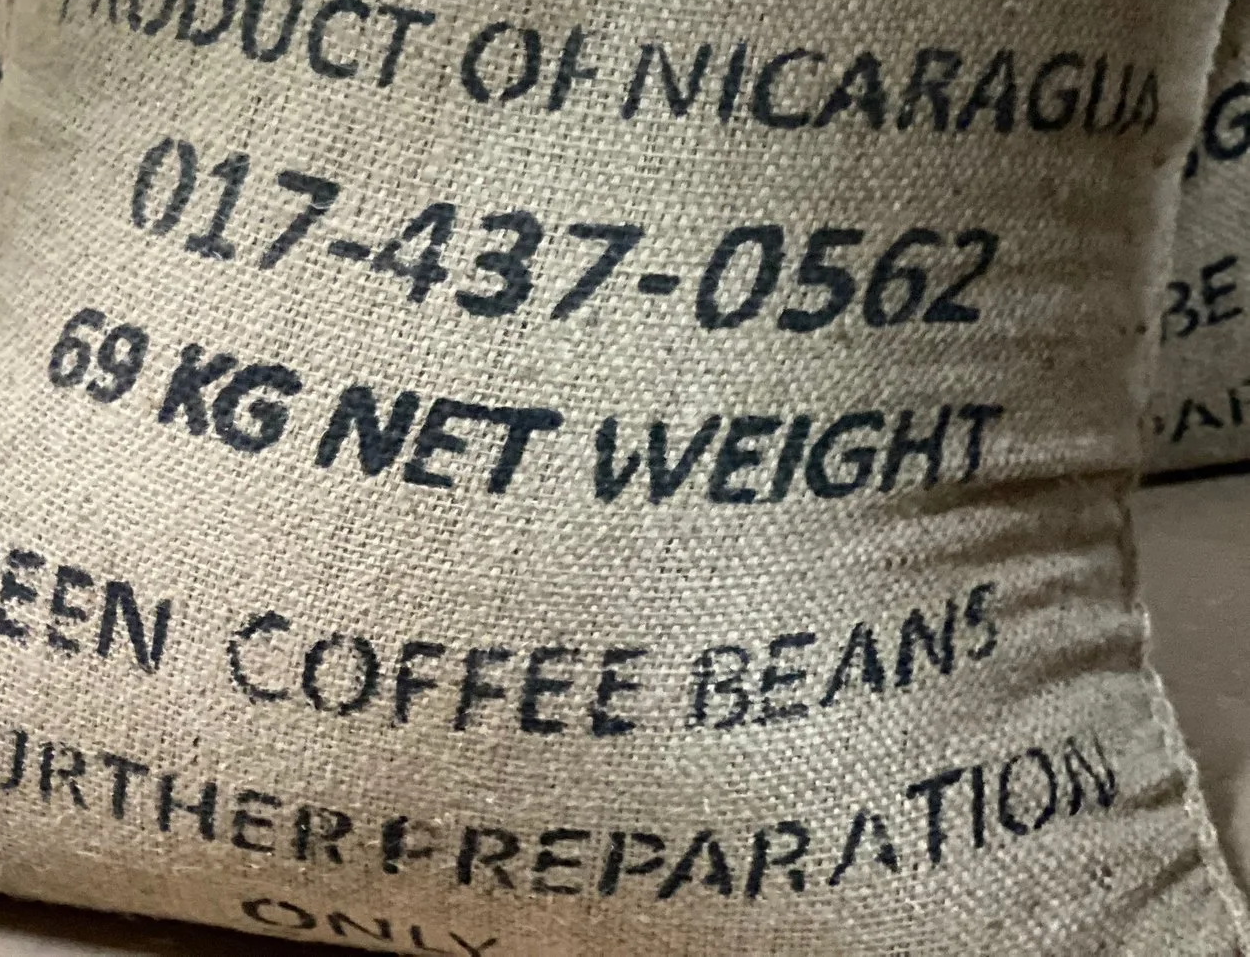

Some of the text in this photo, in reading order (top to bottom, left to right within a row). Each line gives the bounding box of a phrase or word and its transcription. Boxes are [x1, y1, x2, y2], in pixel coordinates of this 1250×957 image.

[460, 20, 600, 112] OF
[621, 40, 1160, 135] NICARAGUA
[130, 136, 1001, 333] 017-437-0562
[49, 307, 1005, 506] 69 KG NET WEIGHT
[225, 609, 648, 738] COFFEE
[684, 581, 1000, 730] BEANS
[380, 731, 1118, 903] PREPARATION
[240, 897, 500, 957] ONLY
